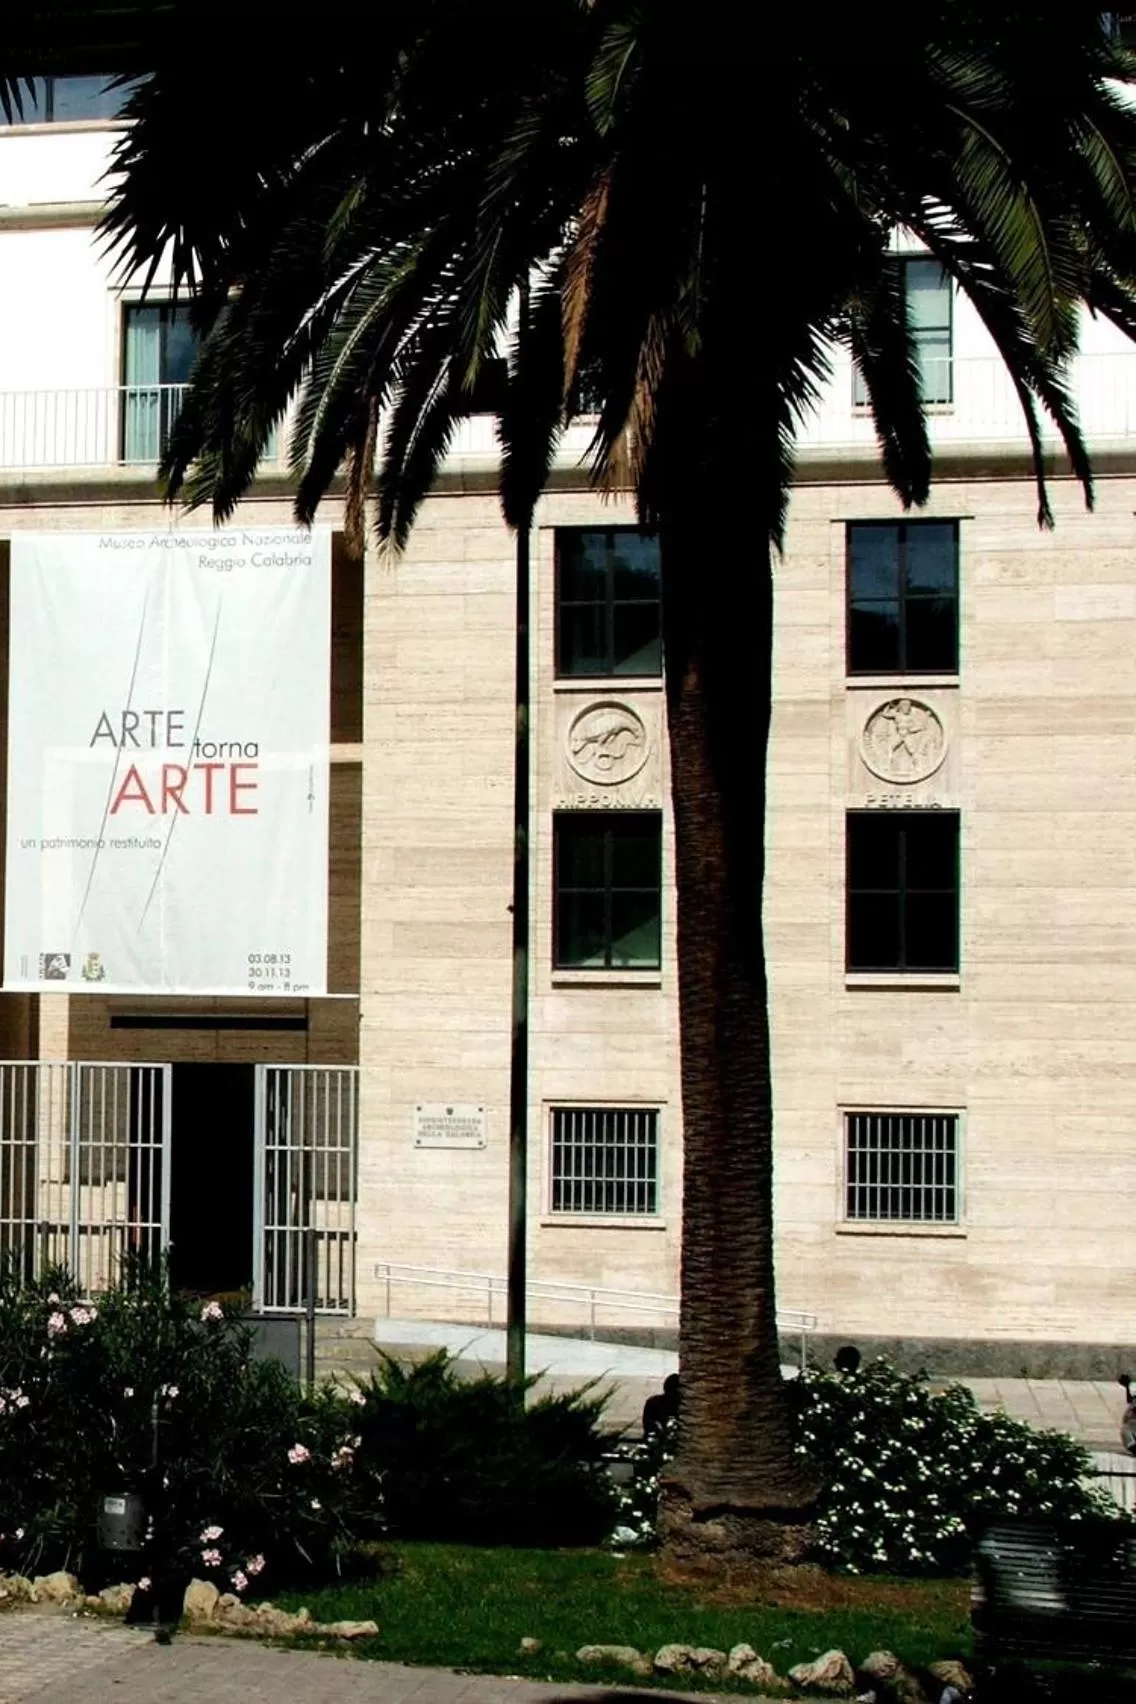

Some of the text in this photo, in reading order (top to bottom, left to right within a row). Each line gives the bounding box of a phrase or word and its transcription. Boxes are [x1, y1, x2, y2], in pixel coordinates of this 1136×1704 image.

[97, 536, 146, 549] Museo
[242, 532, 312, 546] Nazionale
[198, 552, 312, 572] Reggio Calabria
[89, 710, 185, 748] ARTE
[193, 738, 259, 758] torna
[110, 763, 258, 815] ARTE
[19, 836, 162, 852] un patrimonio restituito
[248, 953, 291, 965] 03.08.13
[248, 967, 291, 978] 30.11.13
